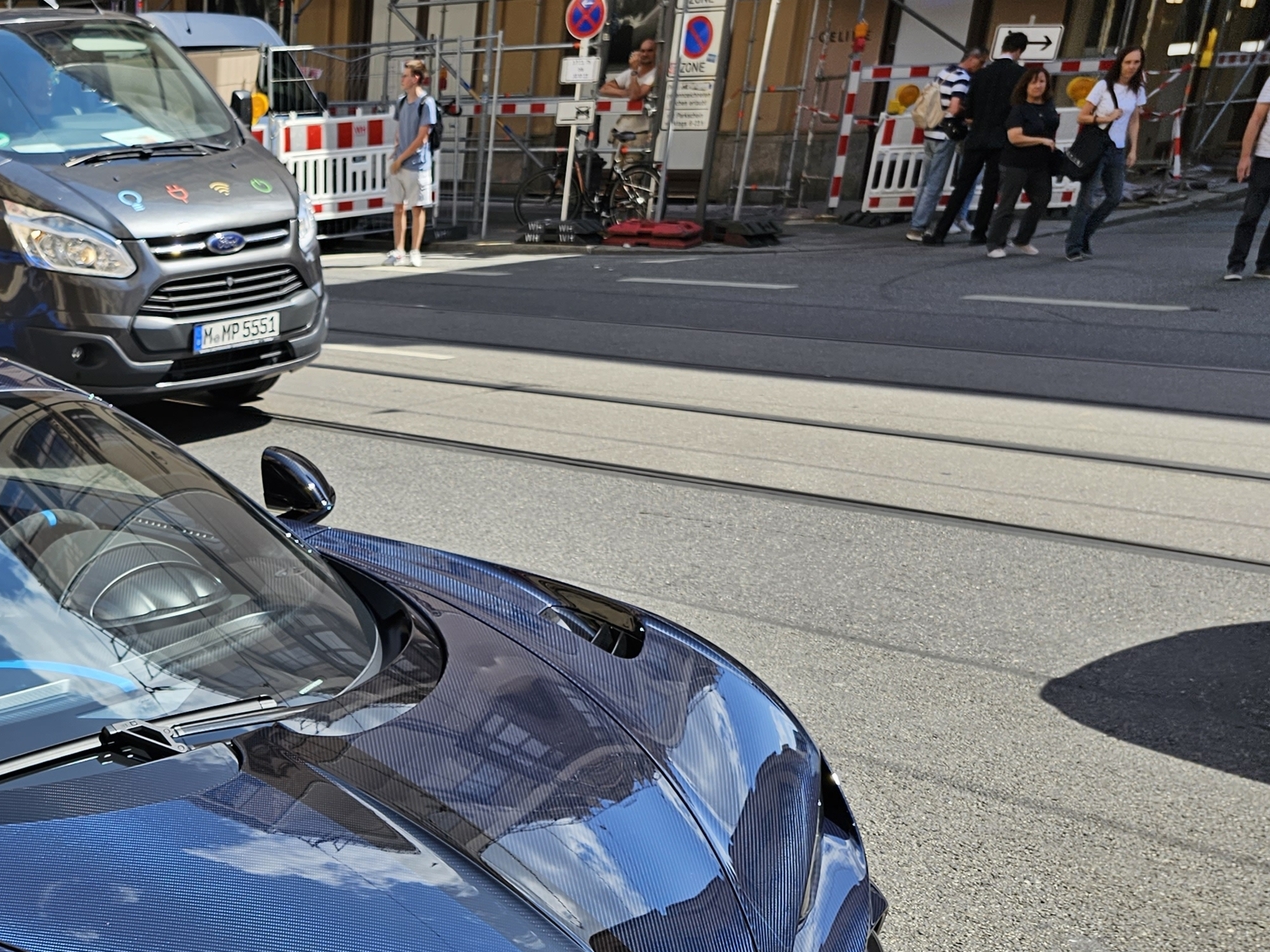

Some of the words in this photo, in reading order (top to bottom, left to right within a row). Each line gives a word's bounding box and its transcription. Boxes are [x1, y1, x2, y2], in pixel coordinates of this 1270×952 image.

[819, 30, 871, 43] CELIE
[680, 62, 706, 73] ZONE
[528, 221, 542, 231] WH
[558, 224, 573, 232] WH
[524, 233, 539, 242] WH
[559, 233, 574, 242] WH
[204, 327, 213, 345] M
[222, 322, 240, 342] MP
[242, 316, 276, 338] 5551
